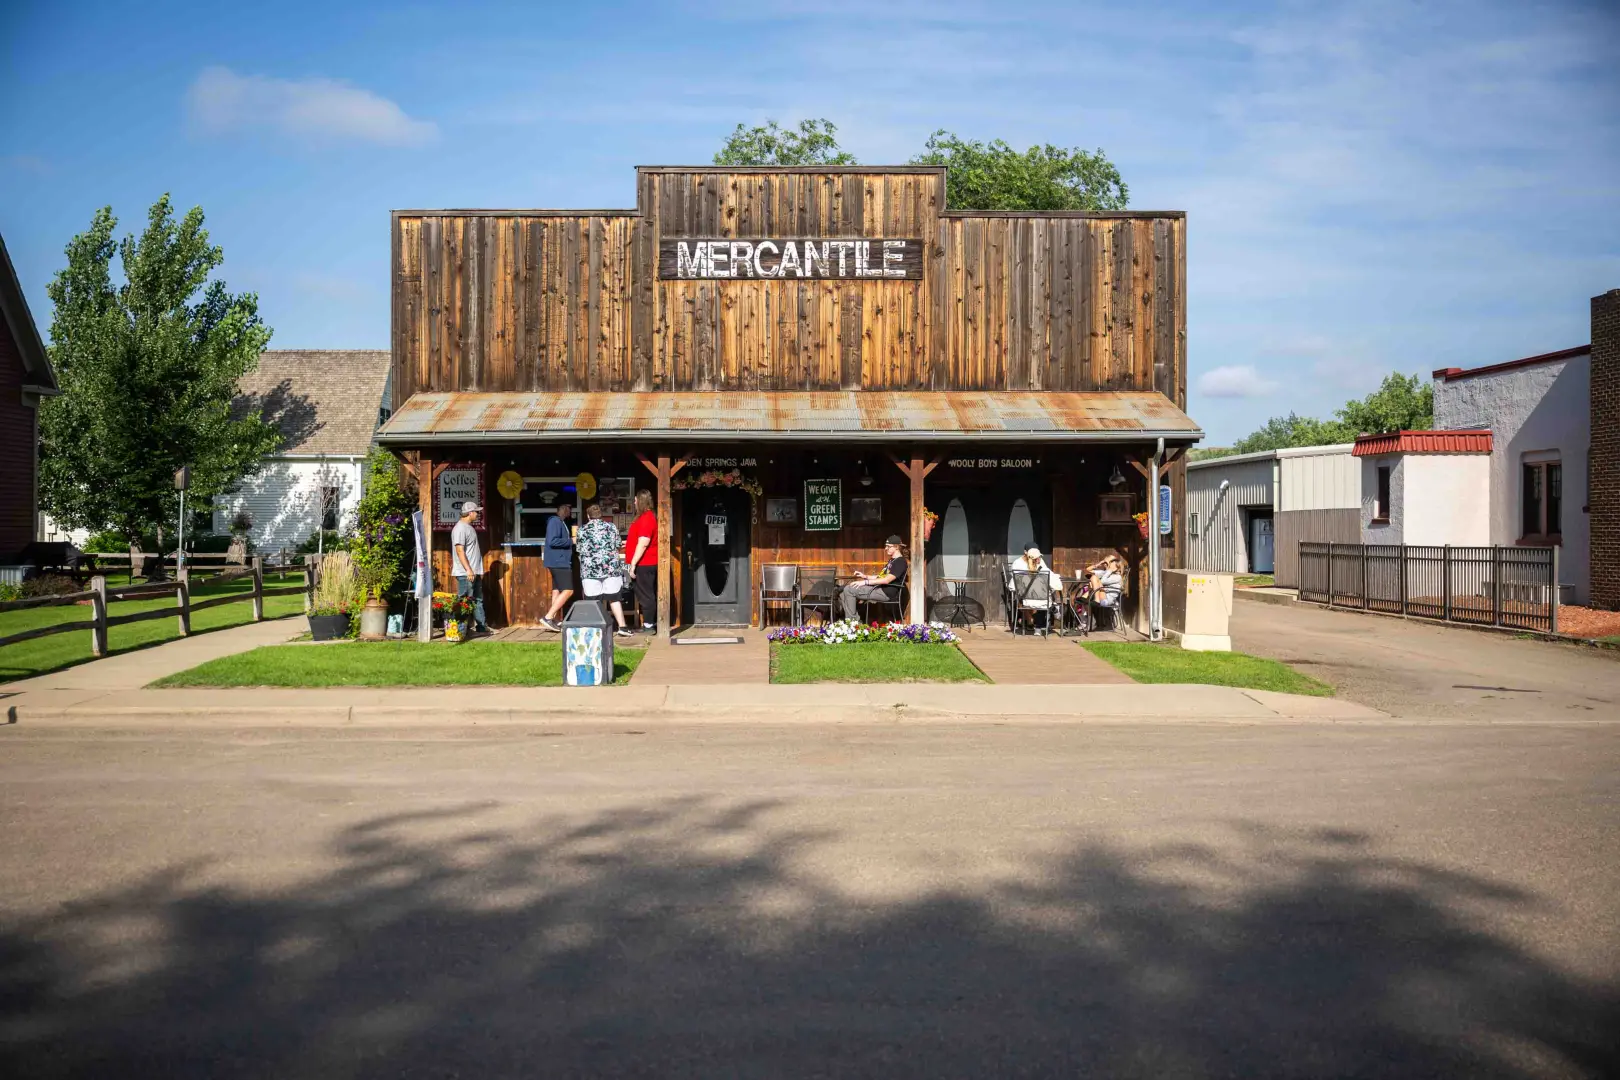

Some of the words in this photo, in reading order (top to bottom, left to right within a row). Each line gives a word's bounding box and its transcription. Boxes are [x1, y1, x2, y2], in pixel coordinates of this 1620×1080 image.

[677, 240, 907, 278] MERCANTILE
[705, 458, 738, 467] SPRINGS
[740, 458, 757, 467] JAVA
[950, 459, 975, 468] WOOLY
[978, 459, 998, 468] BOYS
[1001, 459, 1032, 468] SALOON
[443, 474, 475, 485] Coffee
[444, 487, 475, 499] House
[808, 485, 820, 495] WE
[820, 485, 838, 494] GIVE
[810, 504, 836, 514] GREEN
[706, 515, 726, 525] OPEN
[808, 515, 838, 525] STAMPS
